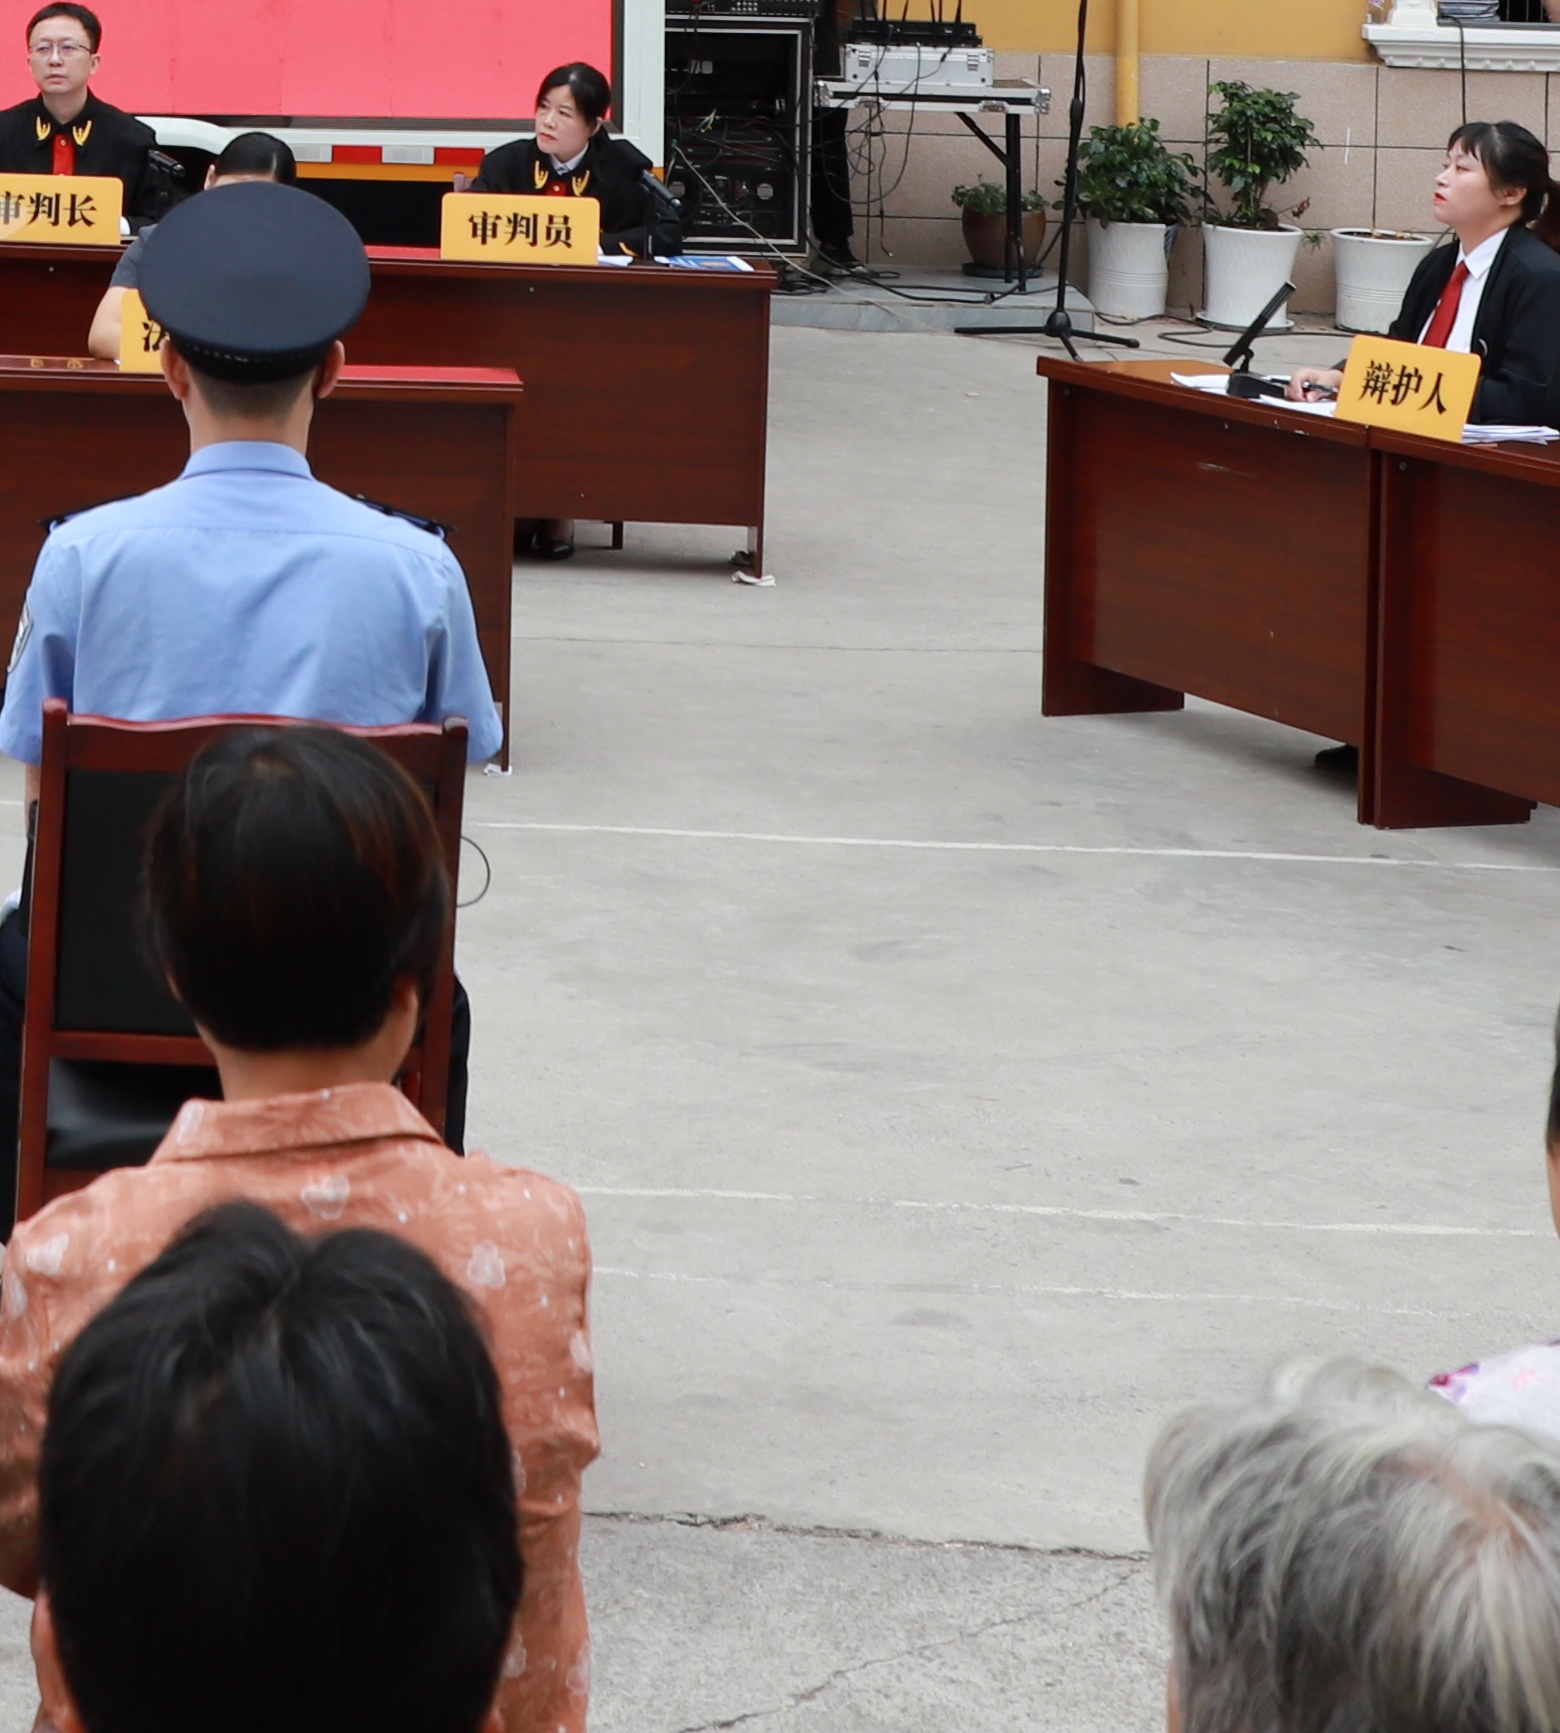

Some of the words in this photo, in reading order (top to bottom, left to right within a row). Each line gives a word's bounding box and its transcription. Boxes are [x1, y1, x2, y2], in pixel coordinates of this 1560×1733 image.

[467, 211, 574, 250] 审判员
[1359, 358, 1448, 416] 辩护人
